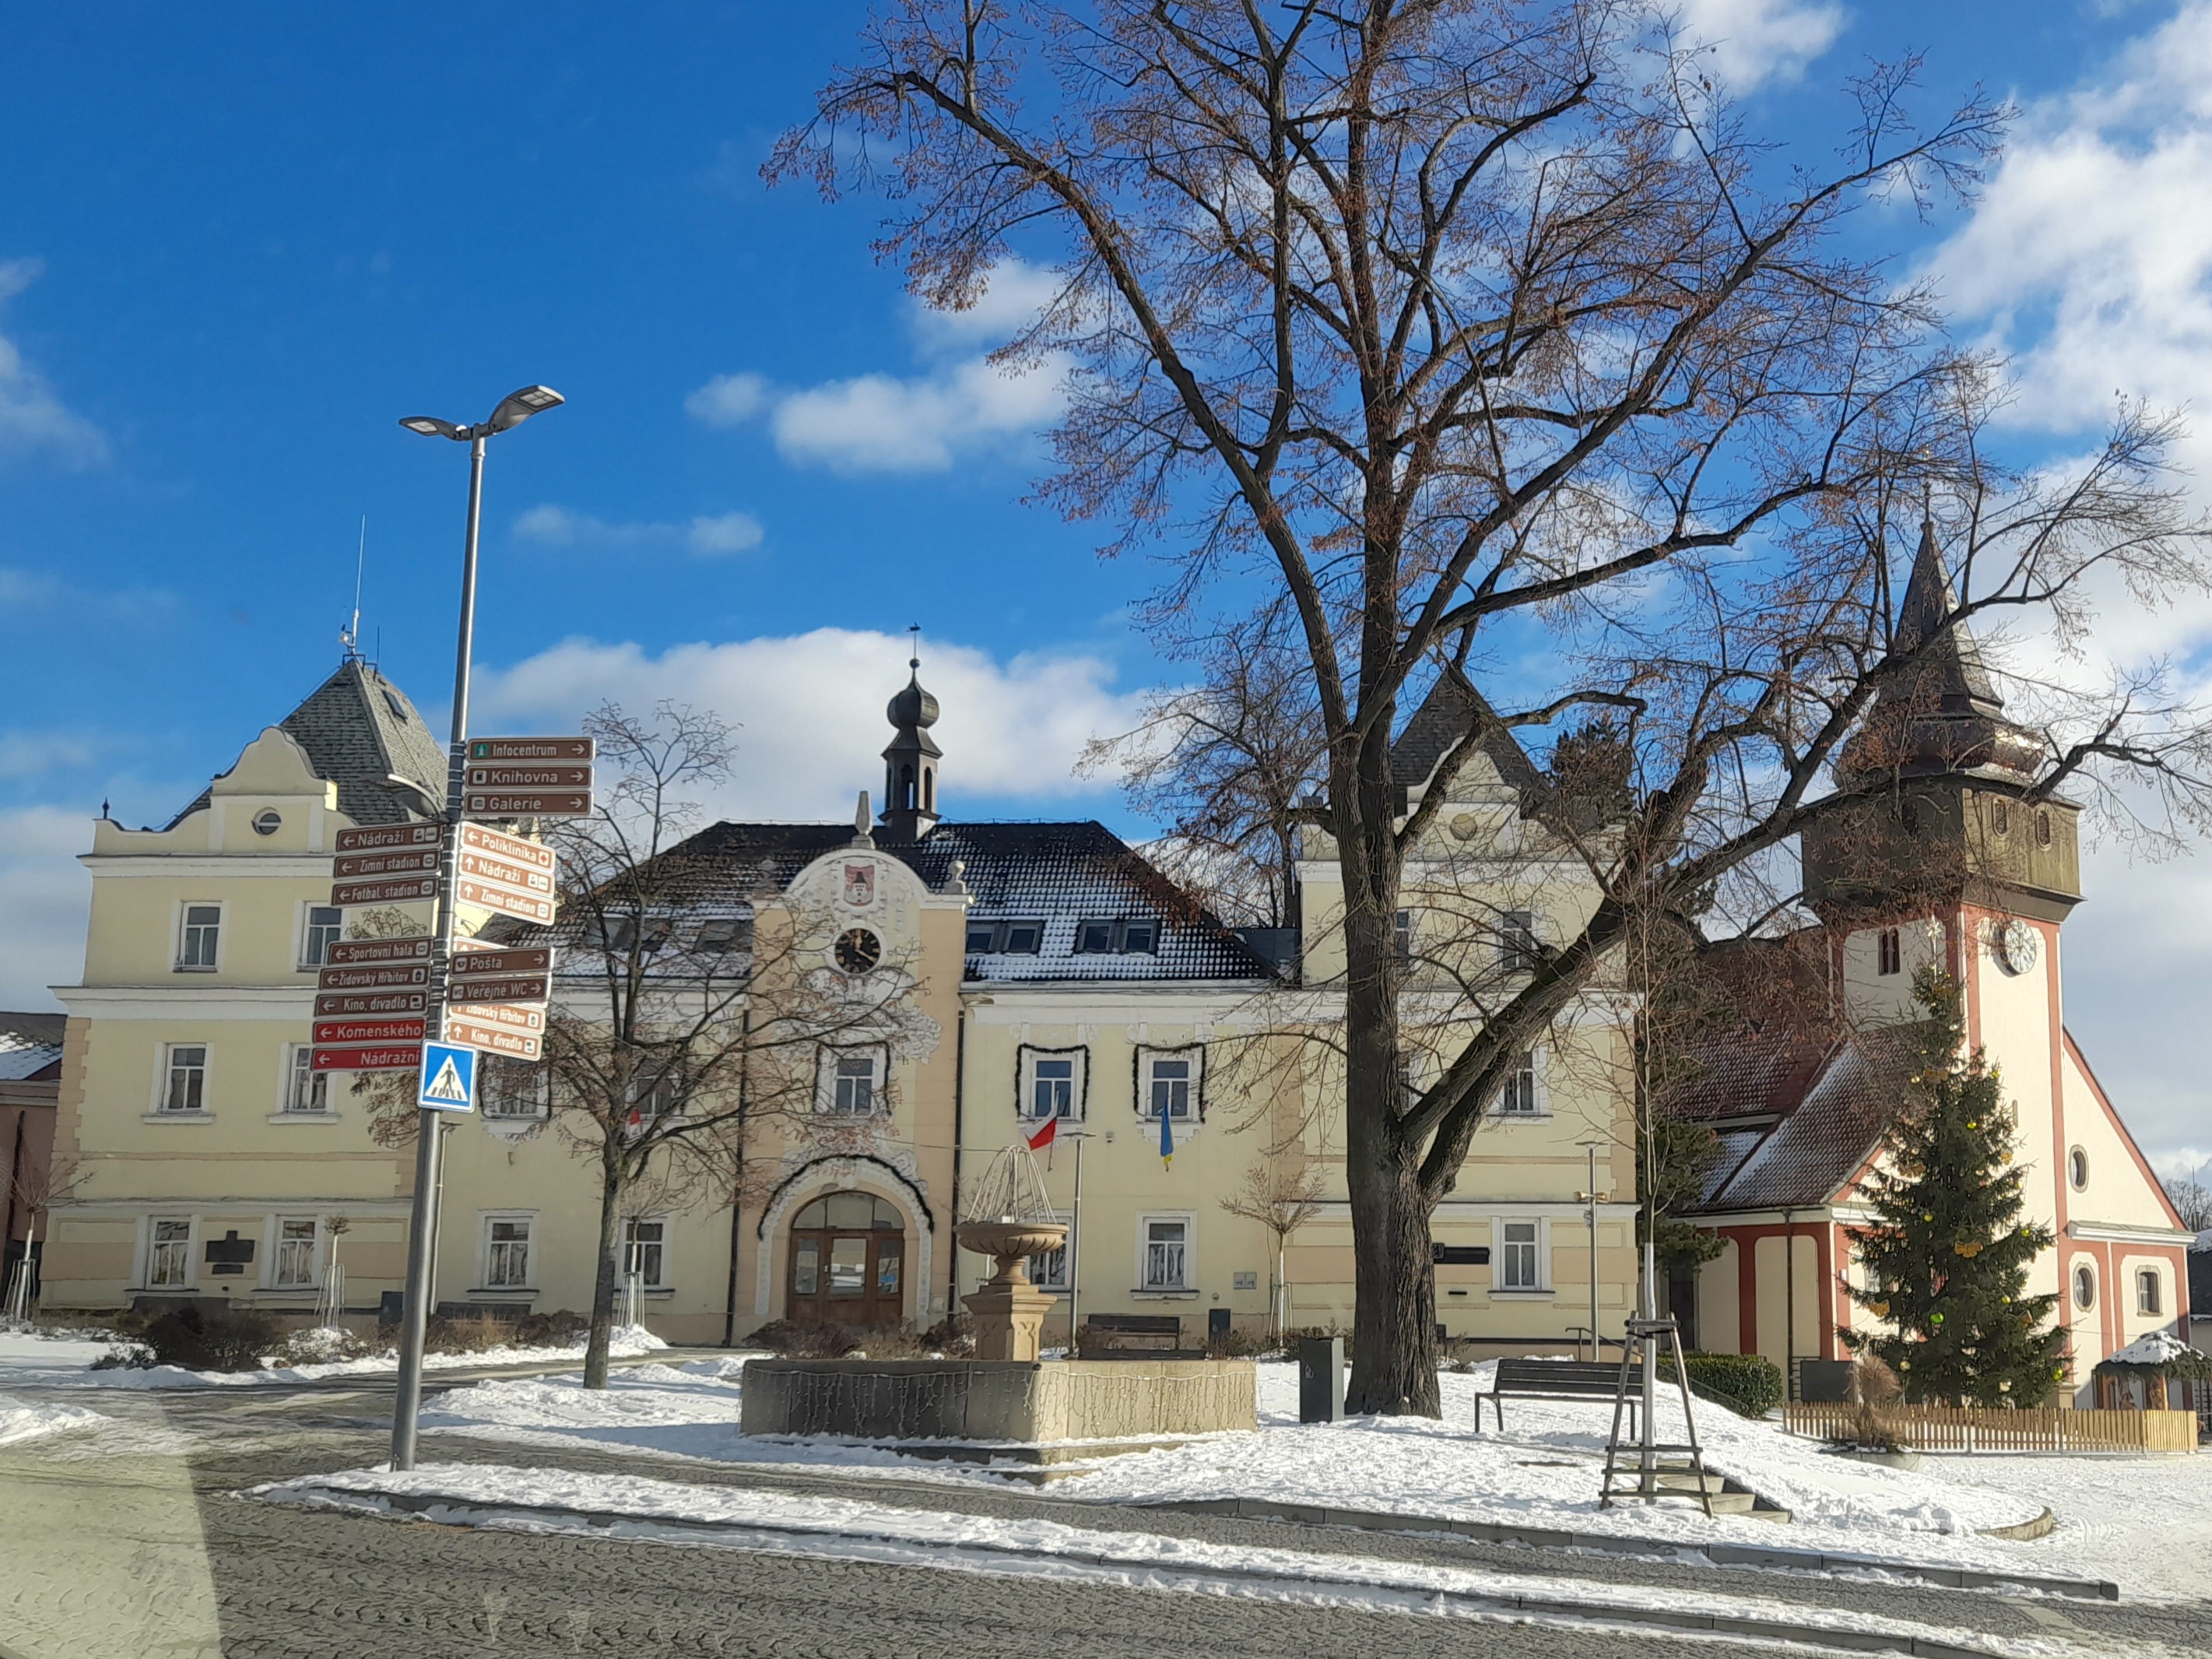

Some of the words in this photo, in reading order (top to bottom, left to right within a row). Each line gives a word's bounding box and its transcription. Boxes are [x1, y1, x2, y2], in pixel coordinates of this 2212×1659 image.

[492, 744, 557, 757] Infocentrum
[491, 770, 558, 784] Knihovna
[490, 796, 542, 810] Galerie
[358, 831, 404, 846] Nádraží
[483, 834, 537, 862] Poliklinika
[360, 857, 385, 873] Zimní
[387, 856, 420, 870] stadion
[479, 859, 520, 883] Nádraží
[384, 883, 419, 898] stadion
[481, 888, 504, 906] Zimní
[506, 897, 535, 915] stadion
[348, 944, 391, 962] Sportovní
[393, 944, 413, 957] hala
[469, 955, 503, 971] Pošta
[339, 972, 377, 986] Židovský
[377, 971, 409, 983] Hřbitov
[467, 984, 507, 1000] Veřejné
[511, 982, 528, 996] WC
[343, 998, 367, 1011] Kino,
[370, 996, 407, 1011] divadlo
[499, 1008, 526, 1024] Hřbitov
[336, 1023, 422, 1039] Komenského
[493, 1033, 523, 1051] divadlo
[360, 1049, 420, 1066] Nádražní
